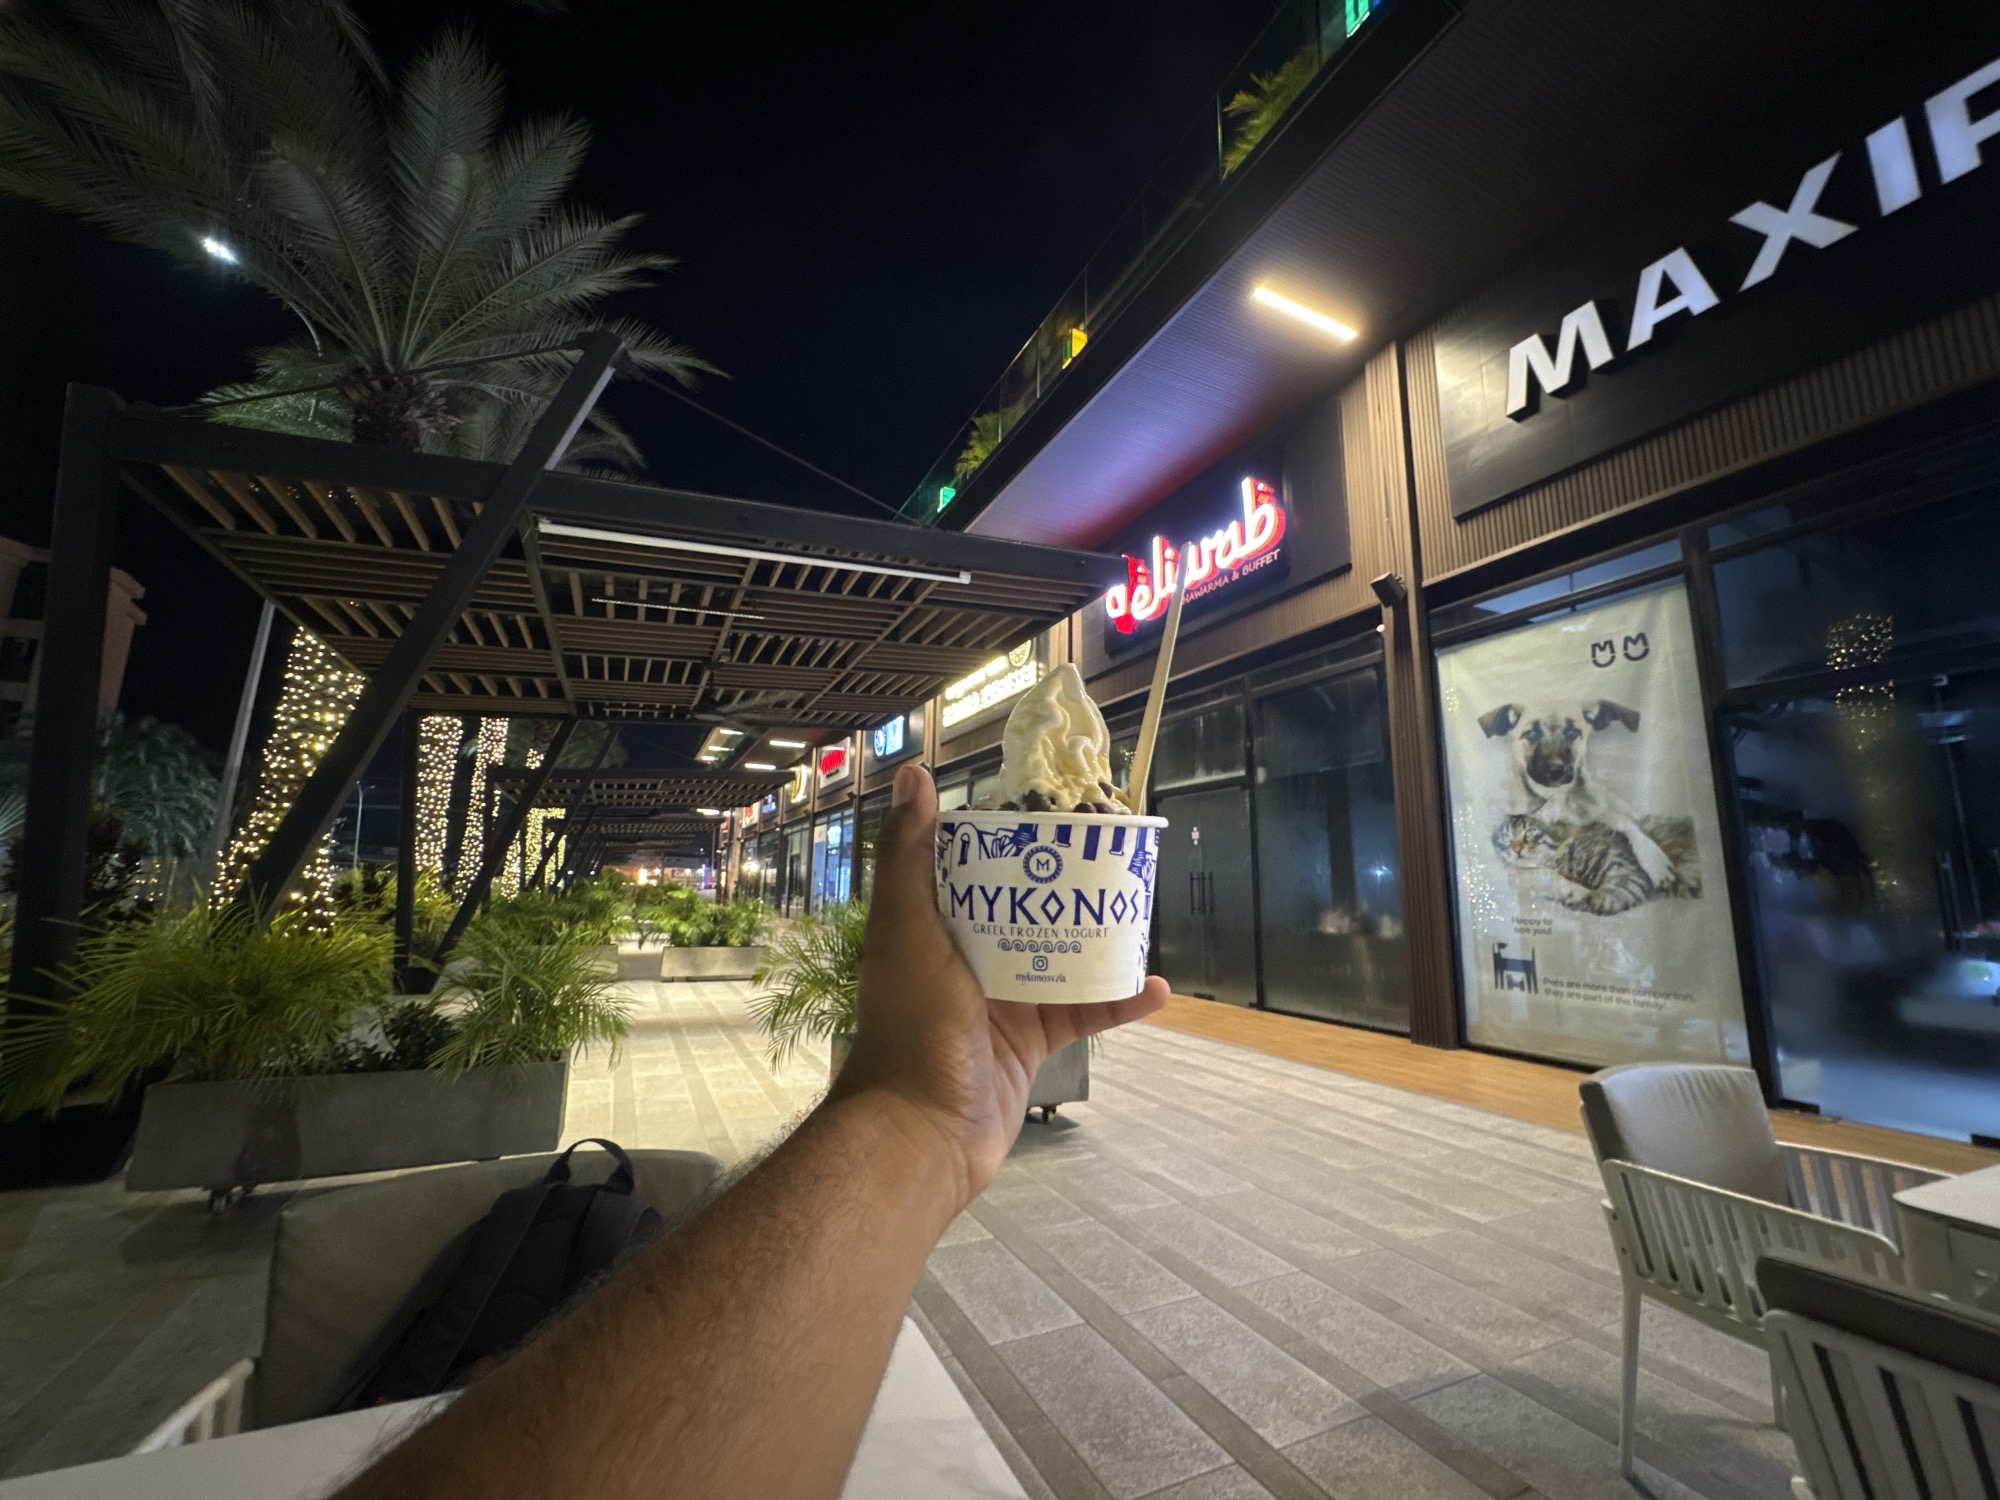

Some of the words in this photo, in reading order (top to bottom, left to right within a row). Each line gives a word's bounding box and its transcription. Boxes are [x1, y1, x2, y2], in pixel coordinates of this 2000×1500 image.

[1181, 576, 1229, 606] HAWARMA
[1231, 570, 1241, 582] &
[1242, 548, 1281, 577] BUFFET
[1036, 858, 1050, 872] M
[949, 883, 1139, 926] MYKONOS
[973, 923, 1005, 936] GREEK
[1010, 925, 1059, 938] FROZEN
[1064, 927, 1109, 939] YOGURT
